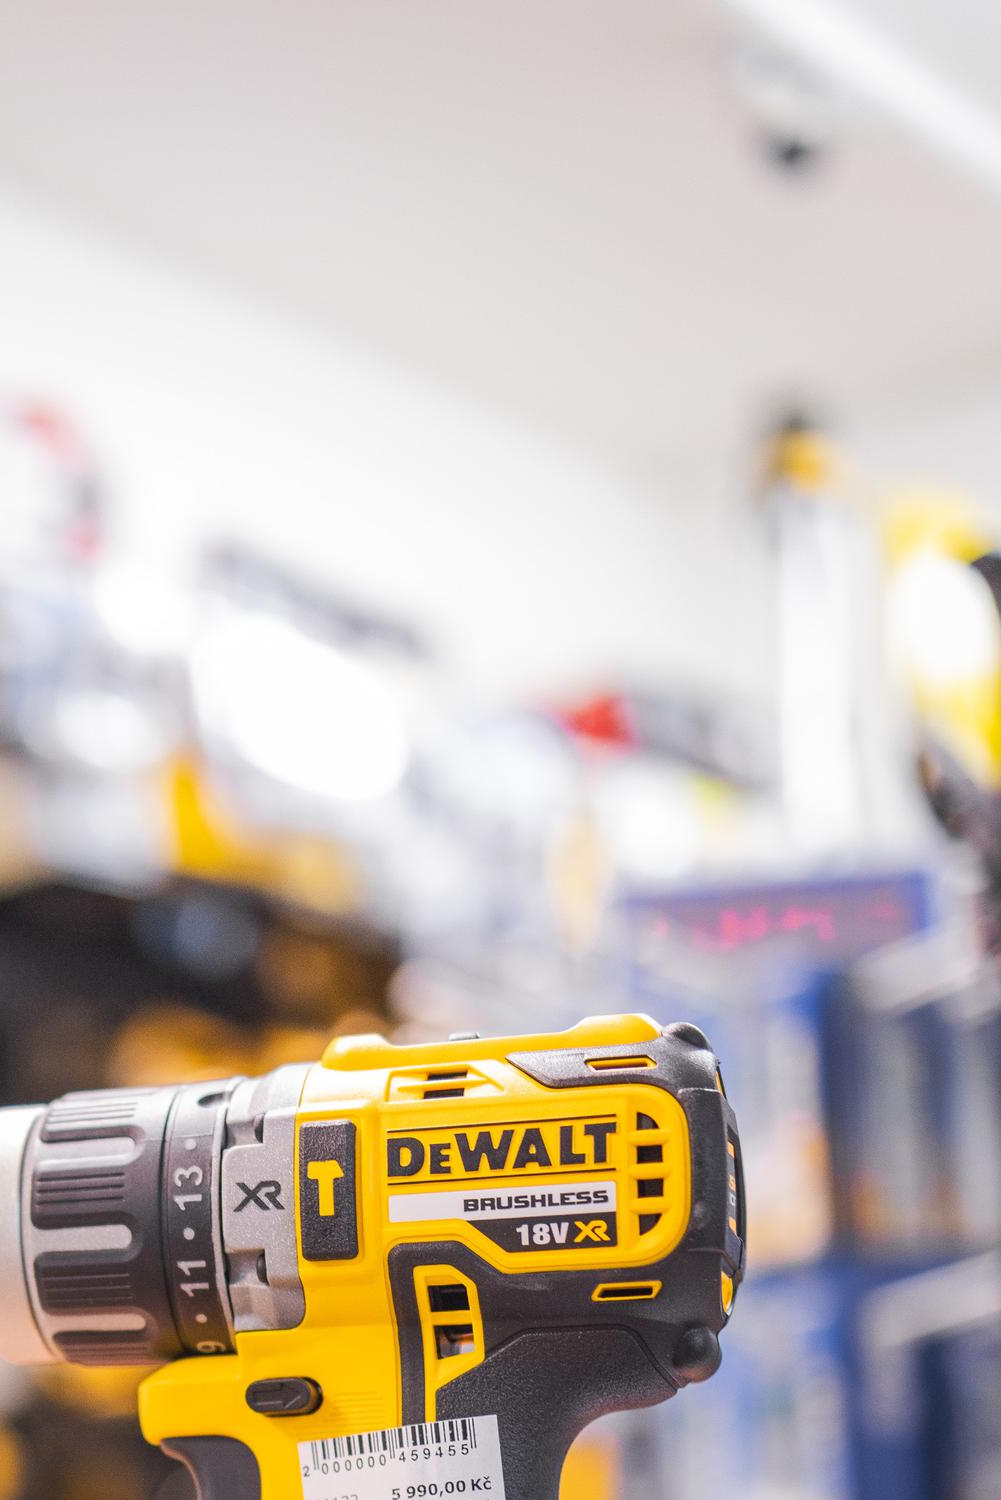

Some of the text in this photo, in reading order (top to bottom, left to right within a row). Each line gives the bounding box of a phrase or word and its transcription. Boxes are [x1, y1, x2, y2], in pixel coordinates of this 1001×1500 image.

[173, 1165, 204, 1211] 13
[233, 1180, 285, 1213] XR
[463, 1190, 609, 1213] BRUSHLESS
[516, 1220, 611, 1246] 18V XR
[176, 1260, 210, 1297] 11
[303, 1443, 470, 1477] 2 000000 459455
[391, 1488, 401, 1500] 5
[406, 1480, 466, 1500] 990,00
[471, 1475, 492, 1493] Kč
